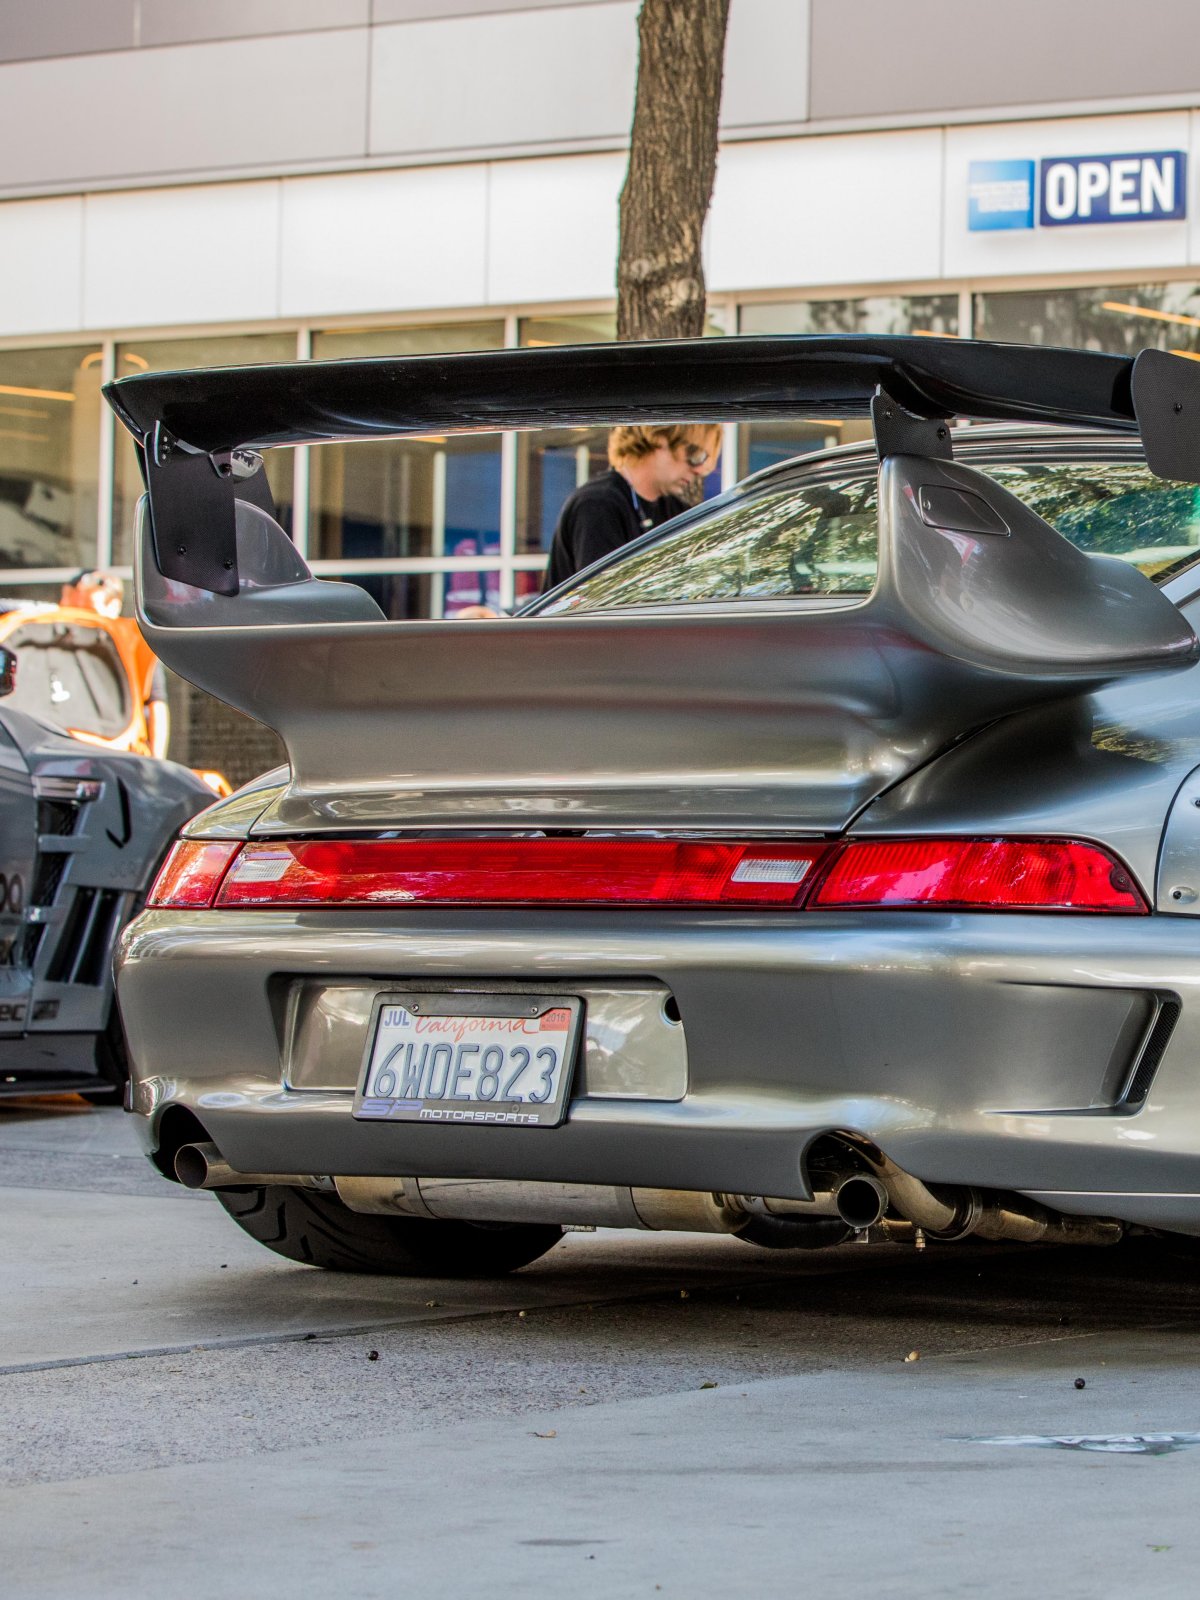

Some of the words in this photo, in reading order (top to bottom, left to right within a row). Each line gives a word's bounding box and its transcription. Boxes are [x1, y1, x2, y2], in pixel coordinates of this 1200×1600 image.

[1045, 156, 1176, 219] OPEN
[384, 1010, 410, 1027] JUL
[545, 1012, 566, 1022] 2016
[415, 1016, 539, 1043] California
[419, 1108, 539, 1124] MOTORSPORTS
